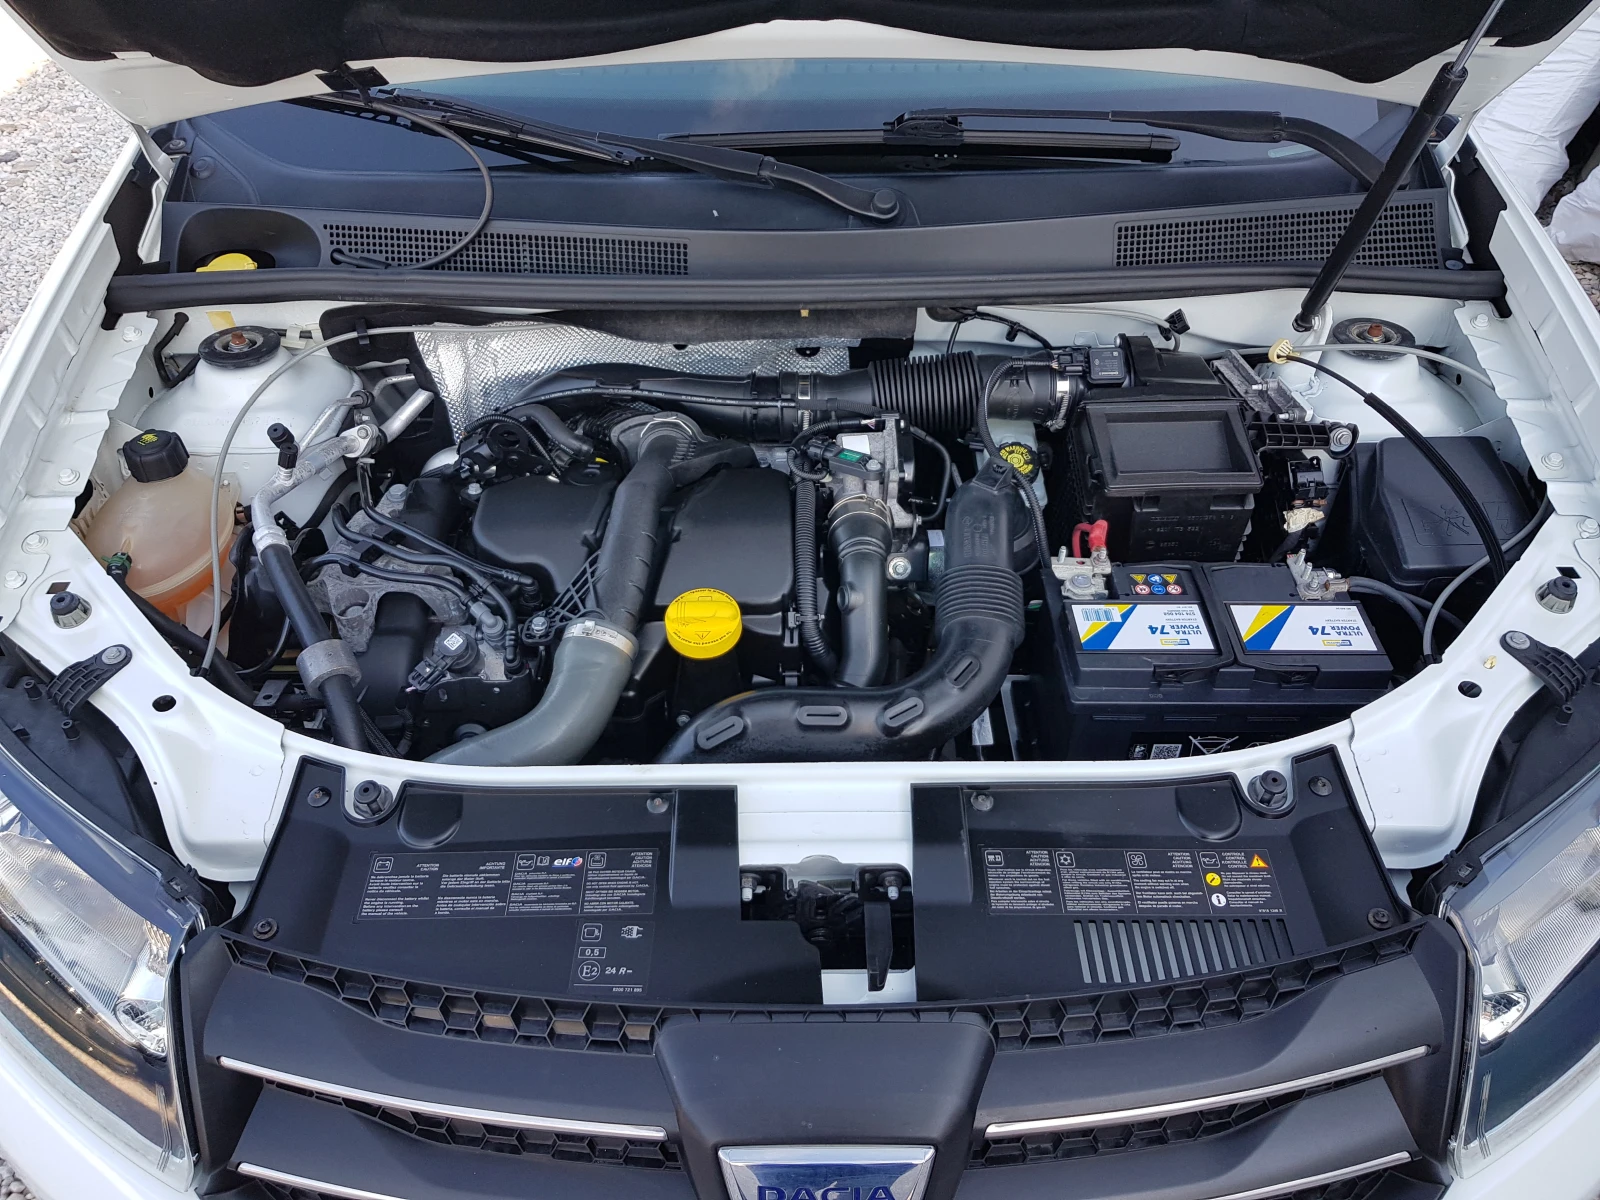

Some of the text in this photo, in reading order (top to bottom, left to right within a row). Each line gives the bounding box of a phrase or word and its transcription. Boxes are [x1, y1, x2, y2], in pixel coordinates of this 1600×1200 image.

[1148, 625, 1170, 634] 74
[1308, 626, 1331, 635] 74
[553, 858, 572, 866] elf
[585, 948, 599, 956] 0,5
[582, 965, 598, 976] E2
[605, 966, 616, 974] 24
[757, 1186, 896, 1200] DACIA
